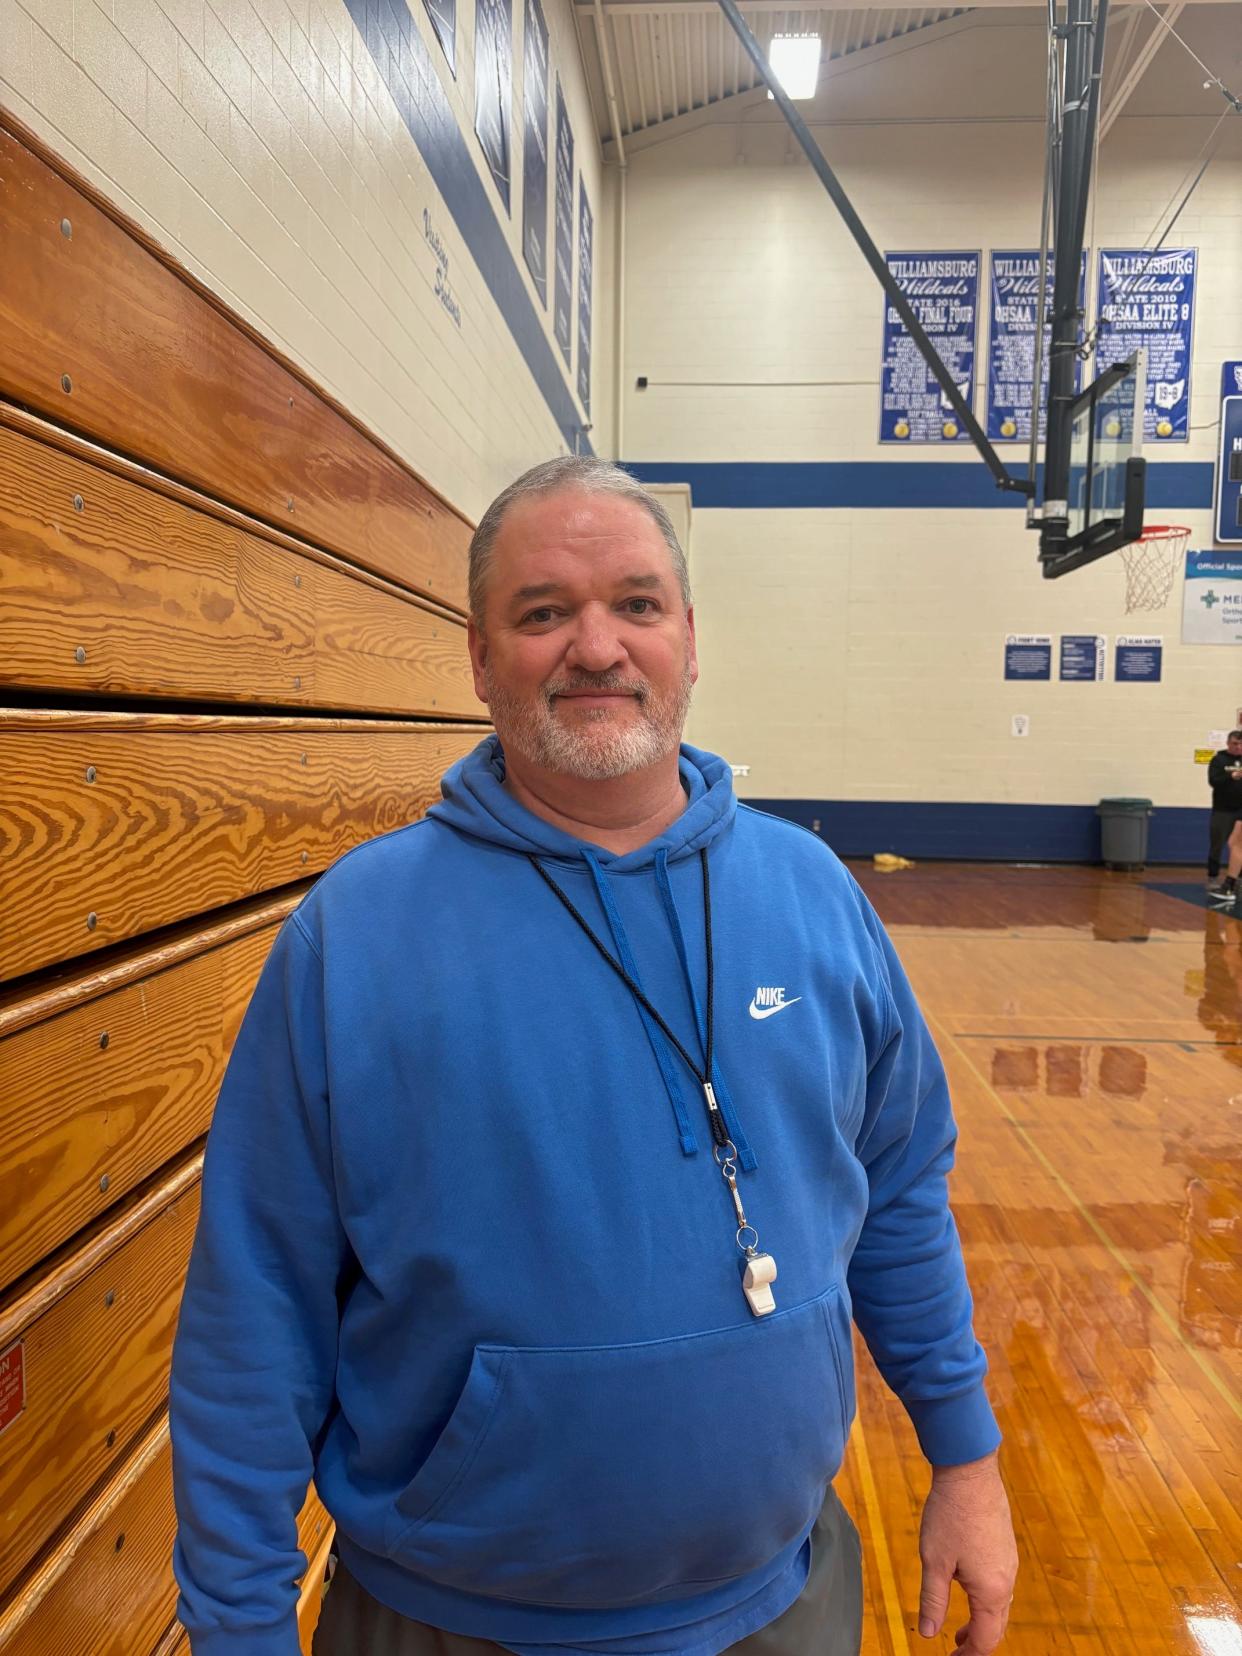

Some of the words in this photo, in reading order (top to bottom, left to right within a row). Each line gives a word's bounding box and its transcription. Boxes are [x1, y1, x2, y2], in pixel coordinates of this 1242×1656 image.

[1103, 257, 1194, 276] WILLIAMSBURG
[1104, 275, 1185, 293] Wildcats
[1142, 304, 1179, 321] ELITE
[1196, 562, 1225, 570] Official
[756, 987, 785, 1006] NIKE
